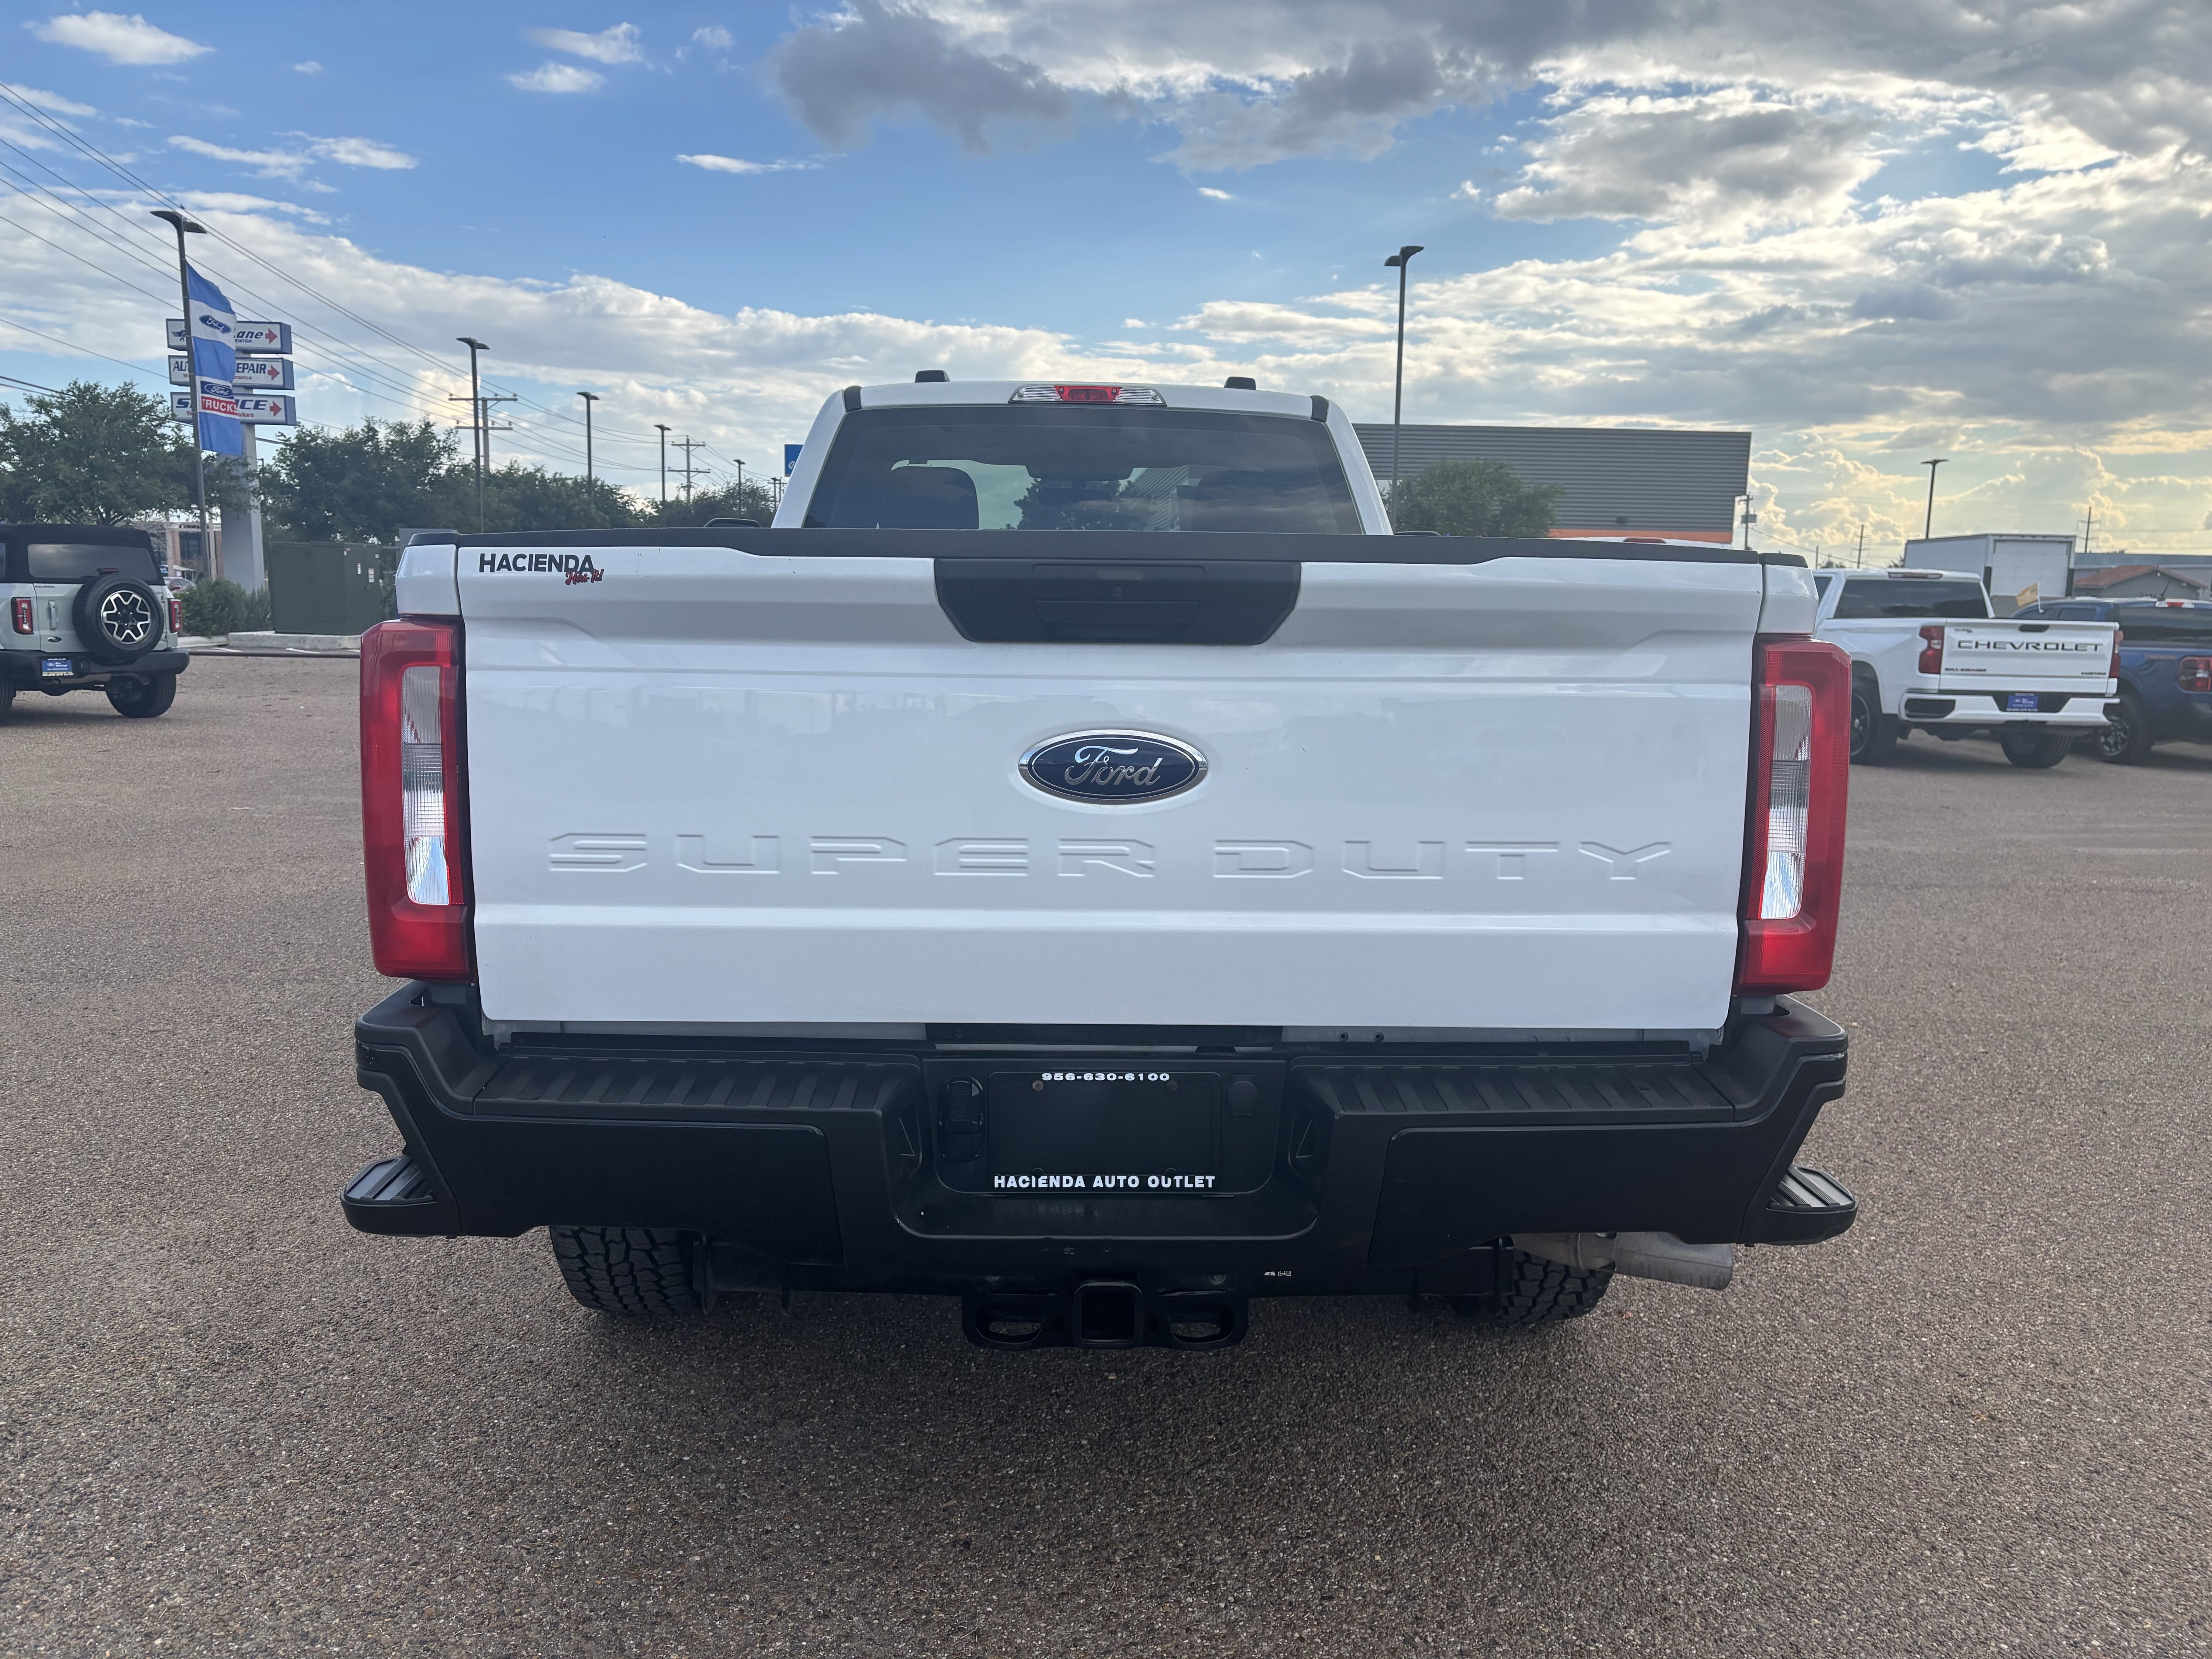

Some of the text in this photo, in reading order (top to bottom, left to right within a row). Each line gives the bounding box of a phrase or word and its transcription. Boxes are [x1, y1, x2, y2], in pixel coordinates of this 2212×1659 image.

[234, 328, 263, 339] ane
[173, 361, 266, 374] AU EPAIR
[210, 385, 230, 396] Ford
[202, 398, 239, 413] TRUCKS
[479, 553, 594, 574] HACIENDA
[1958, 640, 2103, 652] CHEVROLET
[1064, 745, 1163, 786] Ford
[549, 832, 1671, 880] SUPER DUTY
[1041, 1073, 1170, 1081] 956-630-6100
[994, 1175, 1215, 1188] HACIENDA AUTO OUTLET
